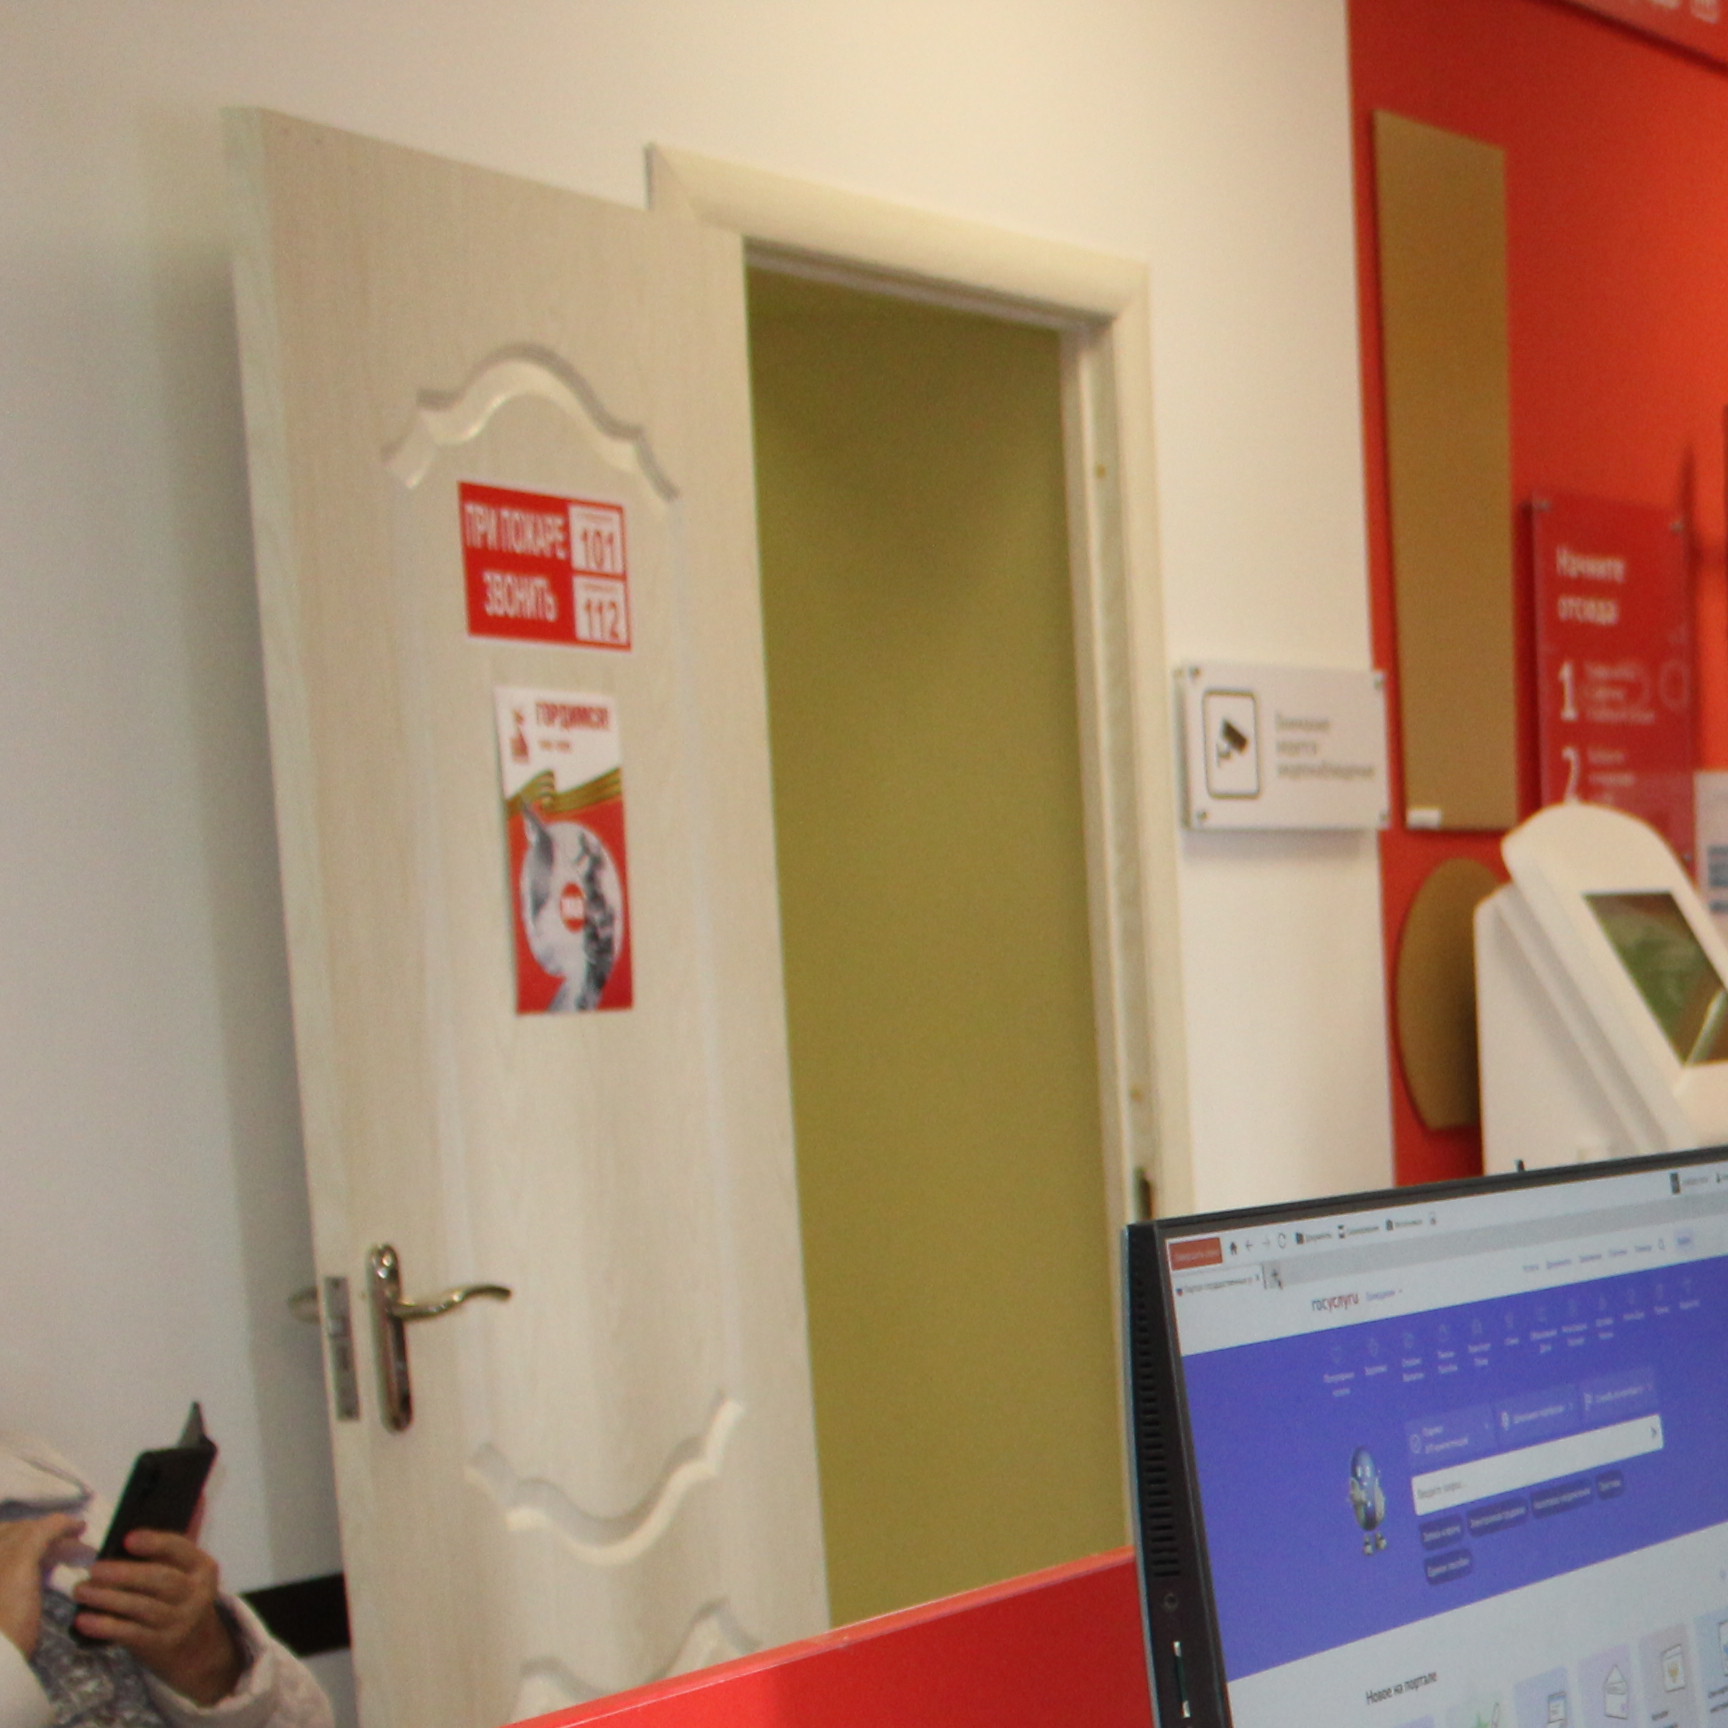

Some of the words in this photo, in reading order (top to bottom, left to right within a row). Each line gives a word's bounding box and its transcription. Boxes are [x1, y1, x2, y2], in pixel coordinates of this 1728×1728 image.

[464, 502, 498, 551] ПРИ
[500, 507, 567, 561] ПОЖАРЕ
[582, 528, 615, 572] 101
[483, 570, 558, 623] ЗВОНИТЬ
[585, 597, 620, 641] 112
[1557, 660, 1579, 723] 1
[1312, 1291, 1360, 1314] госуслуги
[1366, 1687, 1393, 1706] Новое
[1404, 1671, 1438, 1692] портале
